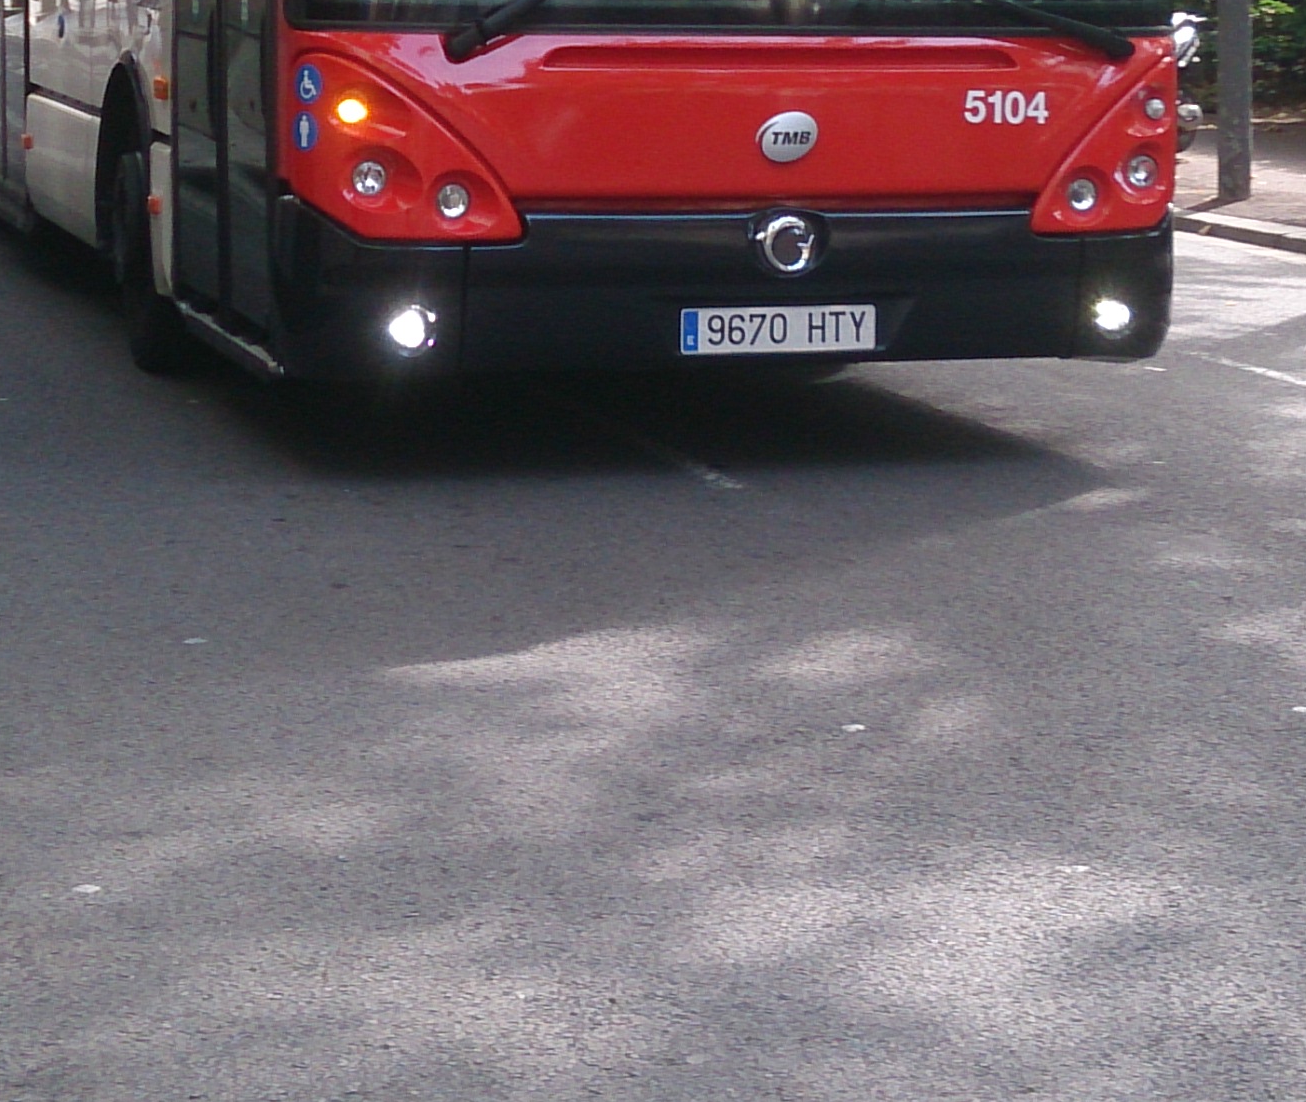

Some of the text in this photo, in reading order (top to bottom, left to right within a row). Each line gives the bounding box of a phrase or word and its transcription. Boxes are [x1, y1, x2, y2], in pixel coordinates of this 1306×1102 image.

[963, 89, 1050, 125] 5104
[771, 130, 812, 146] TMB
[706, 312, 788, 346] 9670
[807, 310, 867, 344] HTY
